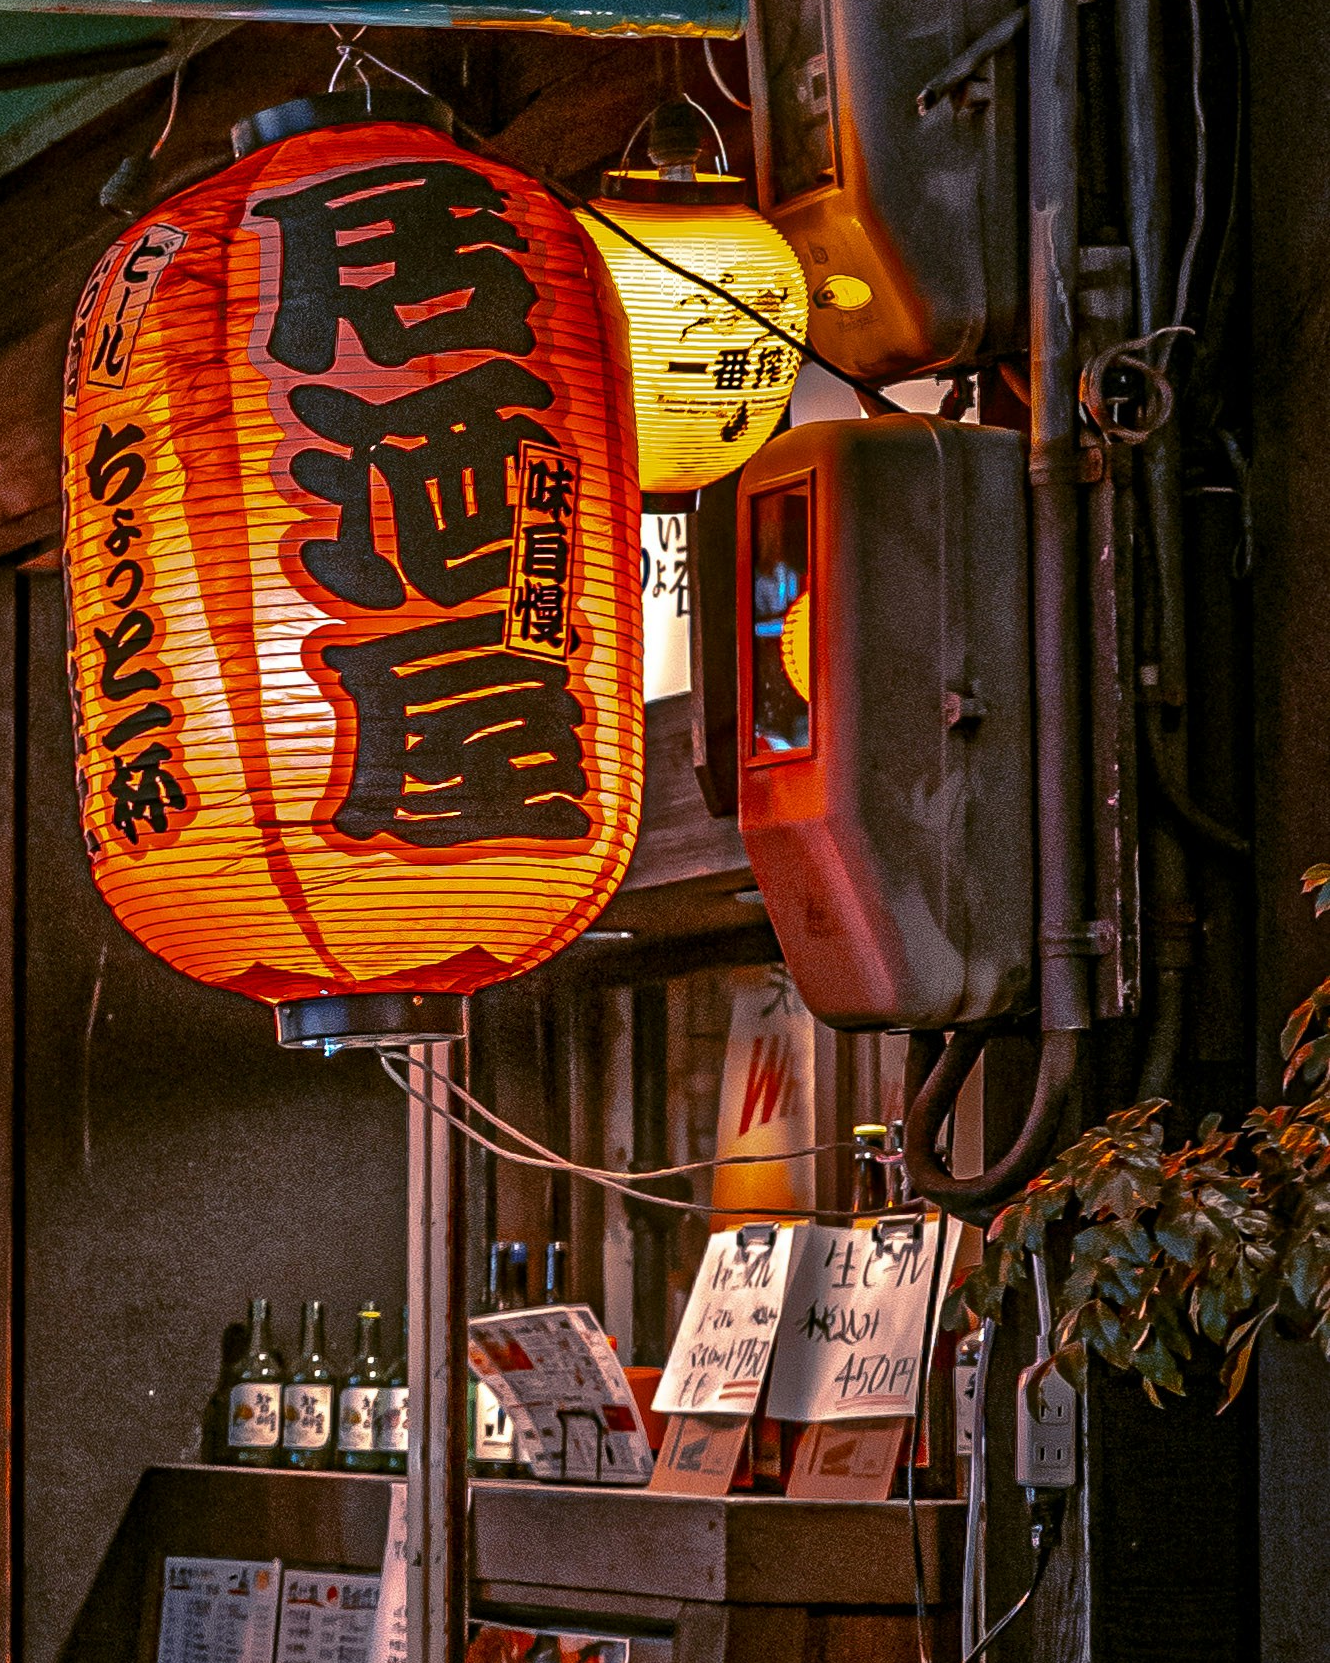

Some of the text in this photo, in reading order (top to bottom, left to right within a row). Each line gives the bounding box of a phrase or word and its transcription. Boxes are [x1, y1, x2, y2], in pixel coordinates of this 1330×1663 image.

[91, 234, 178, 378] ビール
[84, 421, 188, 846] ちょっと一杯
[250, 160, 592, 845] 居酒屋
[515, 458, 574, 649] 味自慢
